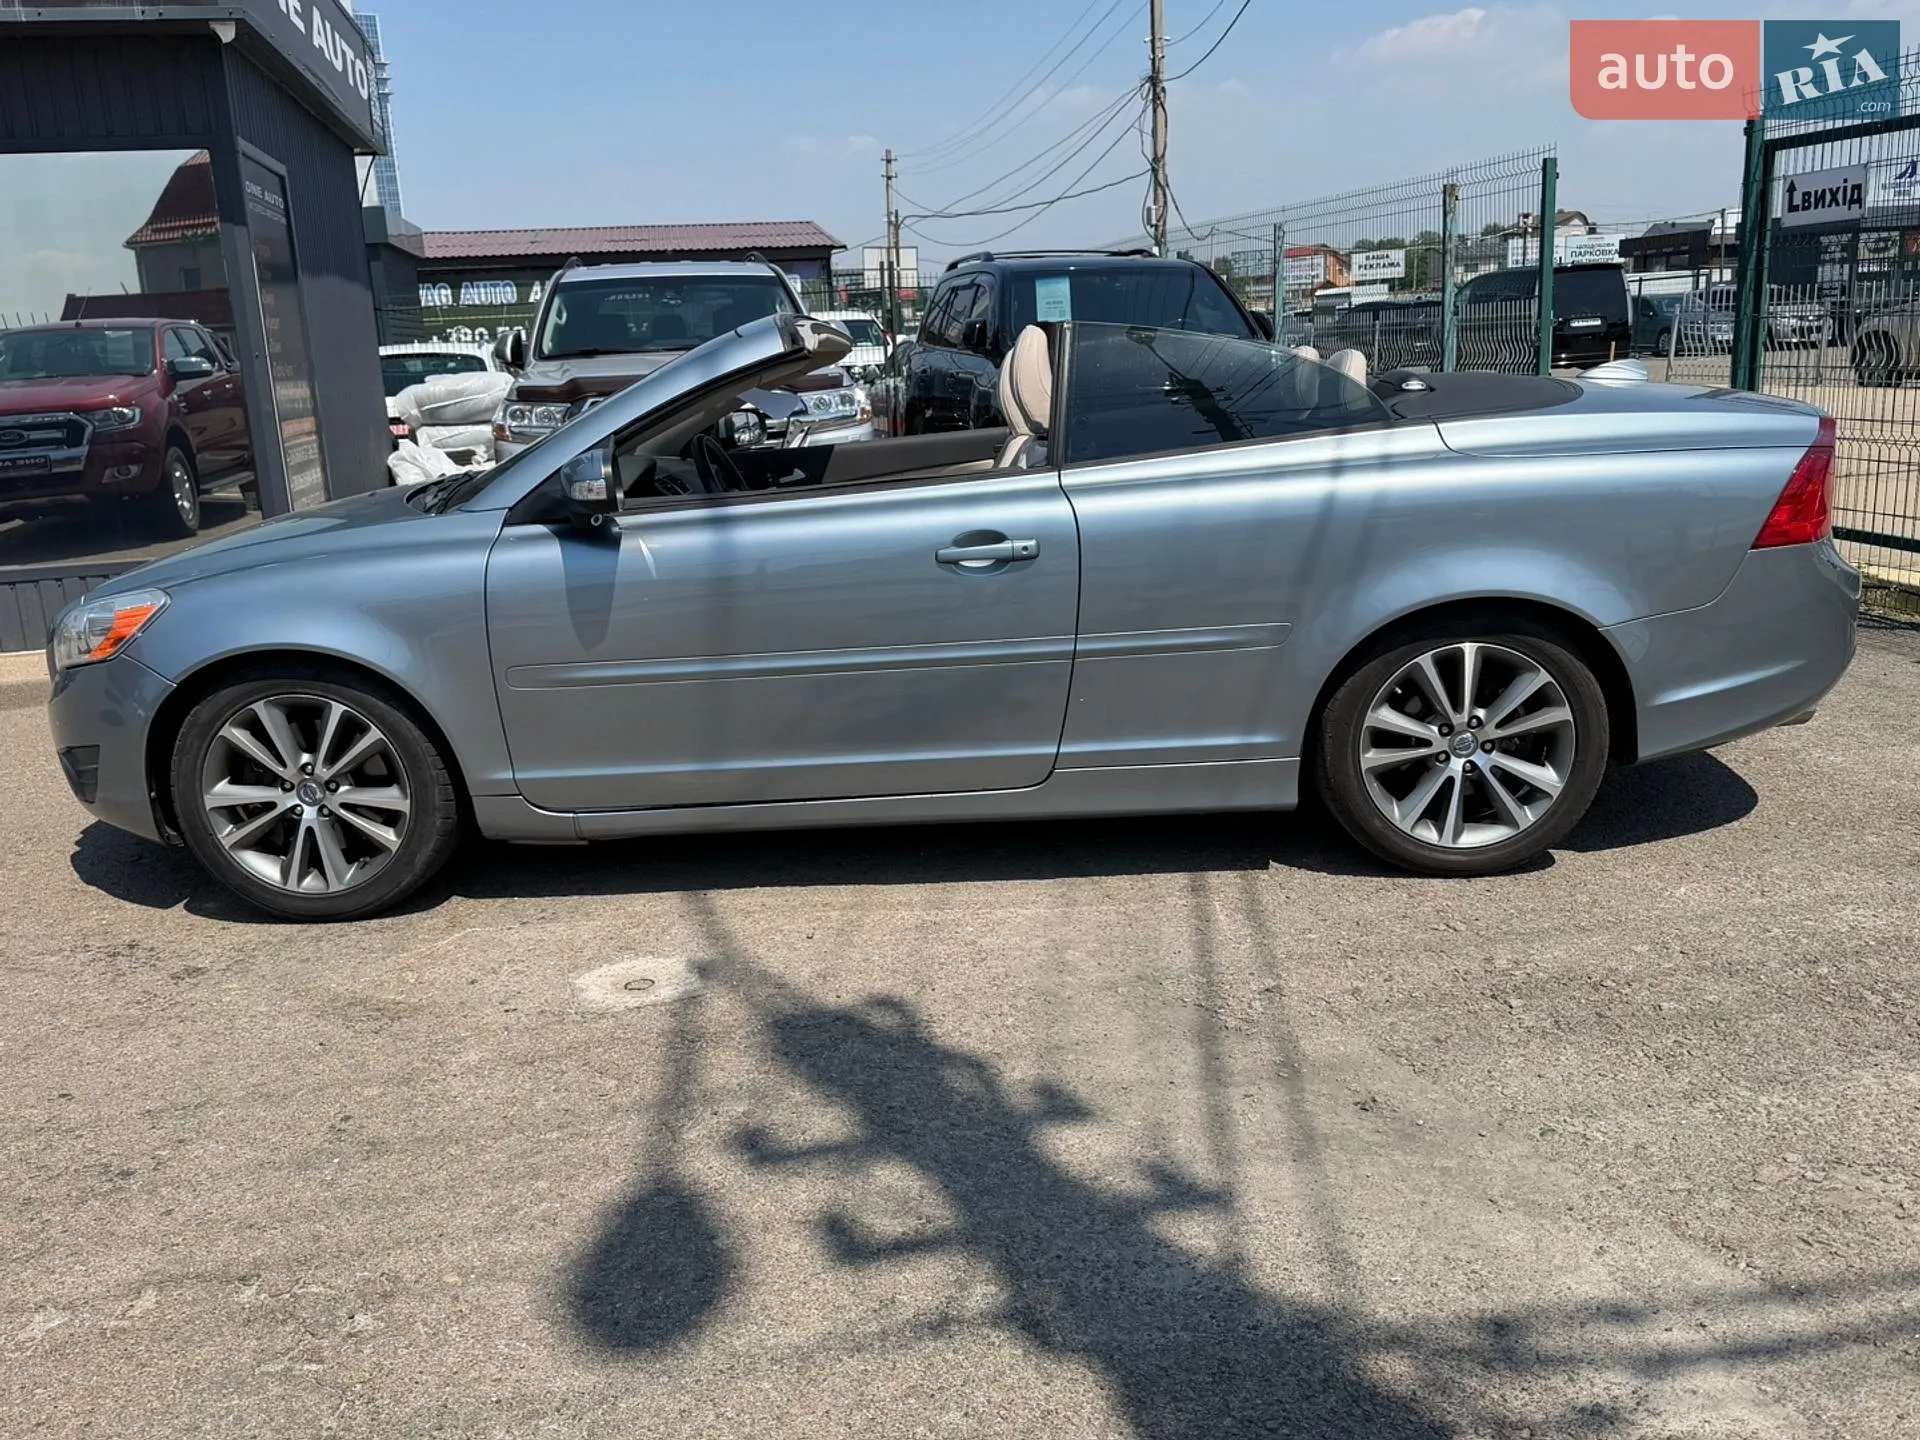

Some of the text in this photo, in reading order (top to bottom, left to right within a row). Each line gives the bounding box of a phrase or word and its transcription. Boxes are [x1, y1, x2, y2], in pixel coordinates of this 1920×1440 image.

[312, 5, 369, 100] AUTO
[264, 190, 284, 208] AUTO
[1570, 248, 1620, 258] ПАРКОВКА
[1358, 261, 1401, 271] РЕКЛАМА
[460, 280, 517, 305] AUTO
